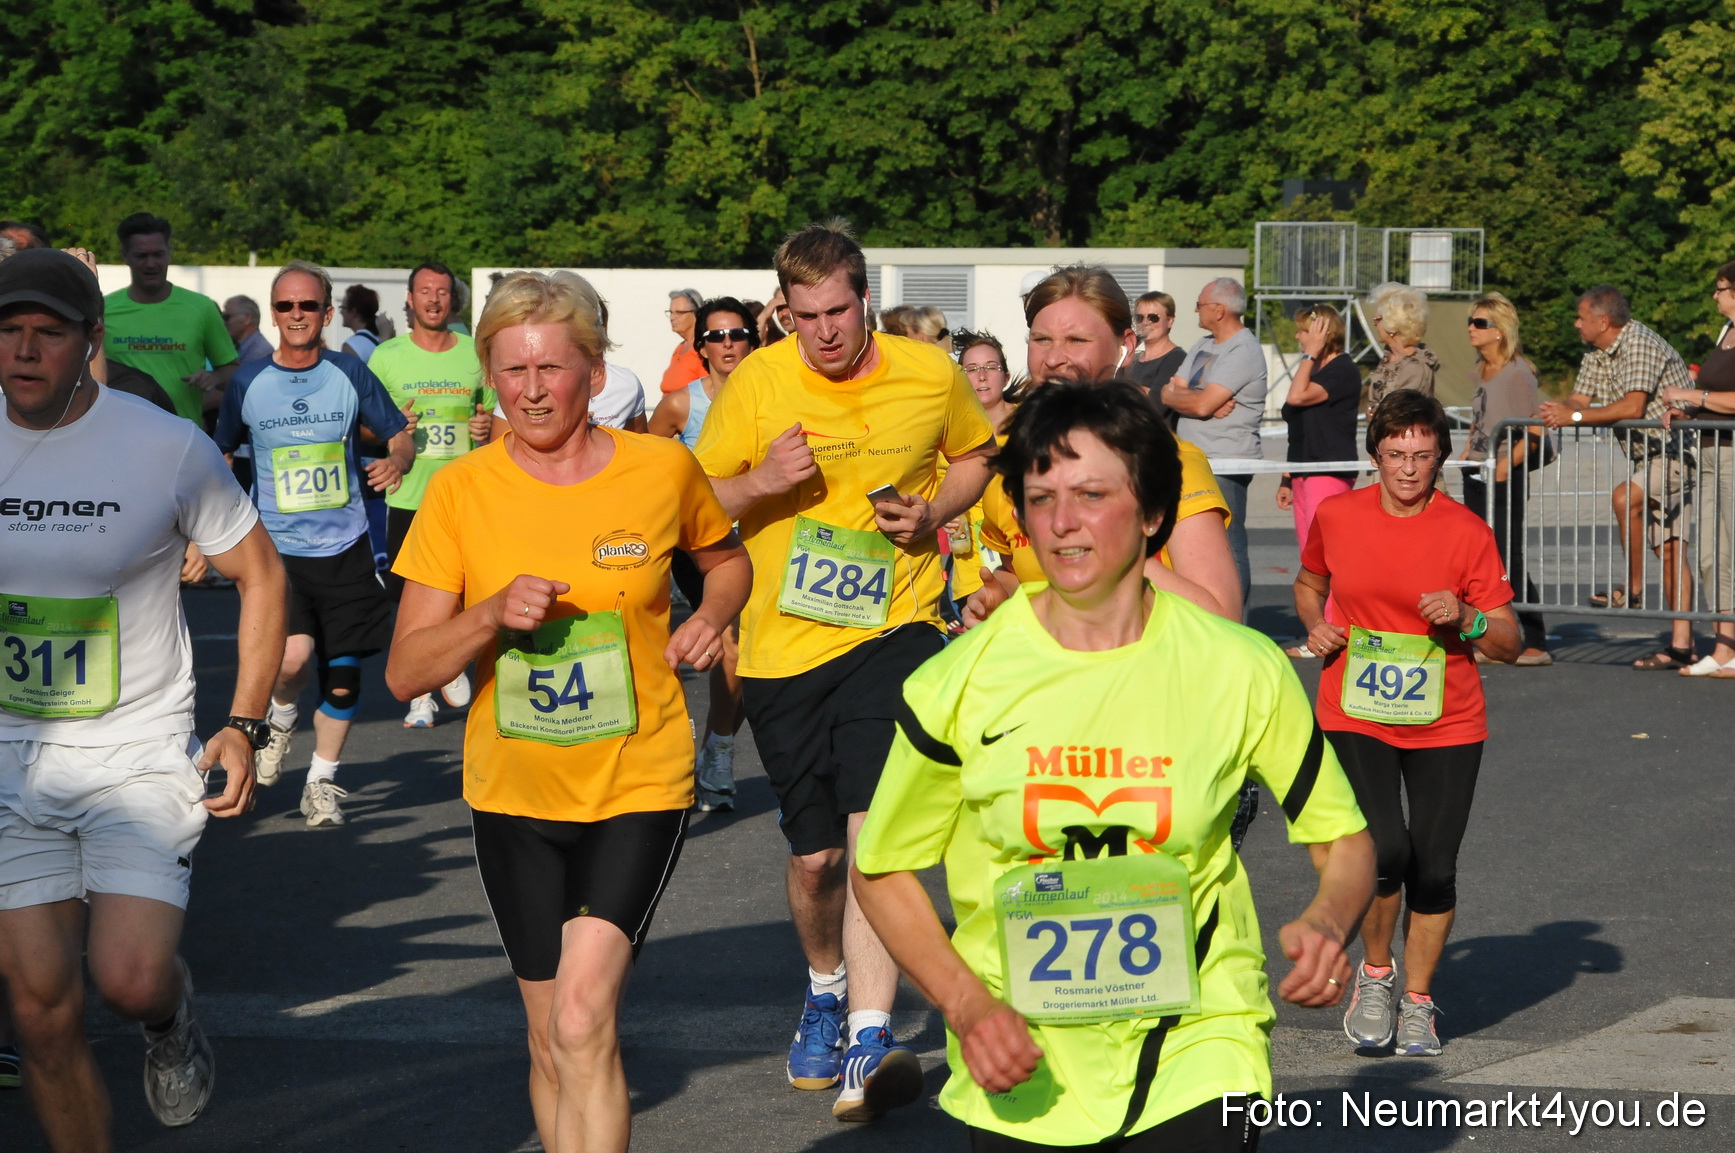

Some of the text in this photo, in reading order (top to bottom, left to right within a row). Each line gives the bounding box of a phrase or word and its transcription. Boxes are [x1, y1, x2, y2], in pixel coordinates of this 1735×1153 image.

[402, 379, 462, 391] autoladen
[418, 386, 472, 396] neumarkt
[291, 429, 314, 438] TEAM
[428, 424, 456, 446] 35
[809, 441, 855, 453] niorenstift
[815, 444, 912, 462] Tiroler Hof Neumarkt
[278, 465, 341, 496] 1201
[0, 498, 121, 521] Egner
[8, 521, 47, 532] stone
[598, 543, 635, 560] plank
[790, 552, 887, 605] 1284
[791, 599, 824, 613] Seniorenstift
[834, 610, 851, 618] Tiroler
[802, 593, 865, 611] Maximilian Gottschalk
[4, 636, 86, 687] 311
[527, 661, 594, 713] 54
[1356, 662, 1428, 701] 492
[9, 694, 25, 703] Egner
[26, 697, 68, 706] Pflastersteine
[22, 687, 75, 697] Joachim Geiger
[1349, 704, 1372, 712] Kaufhaus
[1373, 700, 1390, 708] Marga
[510, 720, 539, 731] Bäckerei
[540, 725, 575, 735] Konditorei
[576, 722, 596, 733] Plank
[597, 719, 620, 729] GmbH
[534, 714, 593, 725] Monika Mederer
[1026, 745, 1173, 779] Müller
[1061, 825, 1136, 861] M
[1024, 886, 1091, 902] firmenlauf
[1026, 913, 1163, 982] 278
[1054, 981, 1146, 995] Rosmarie Vöstner
[1042, 994, 1159, 1010] Drogeriemarkt Müller Ltd.
